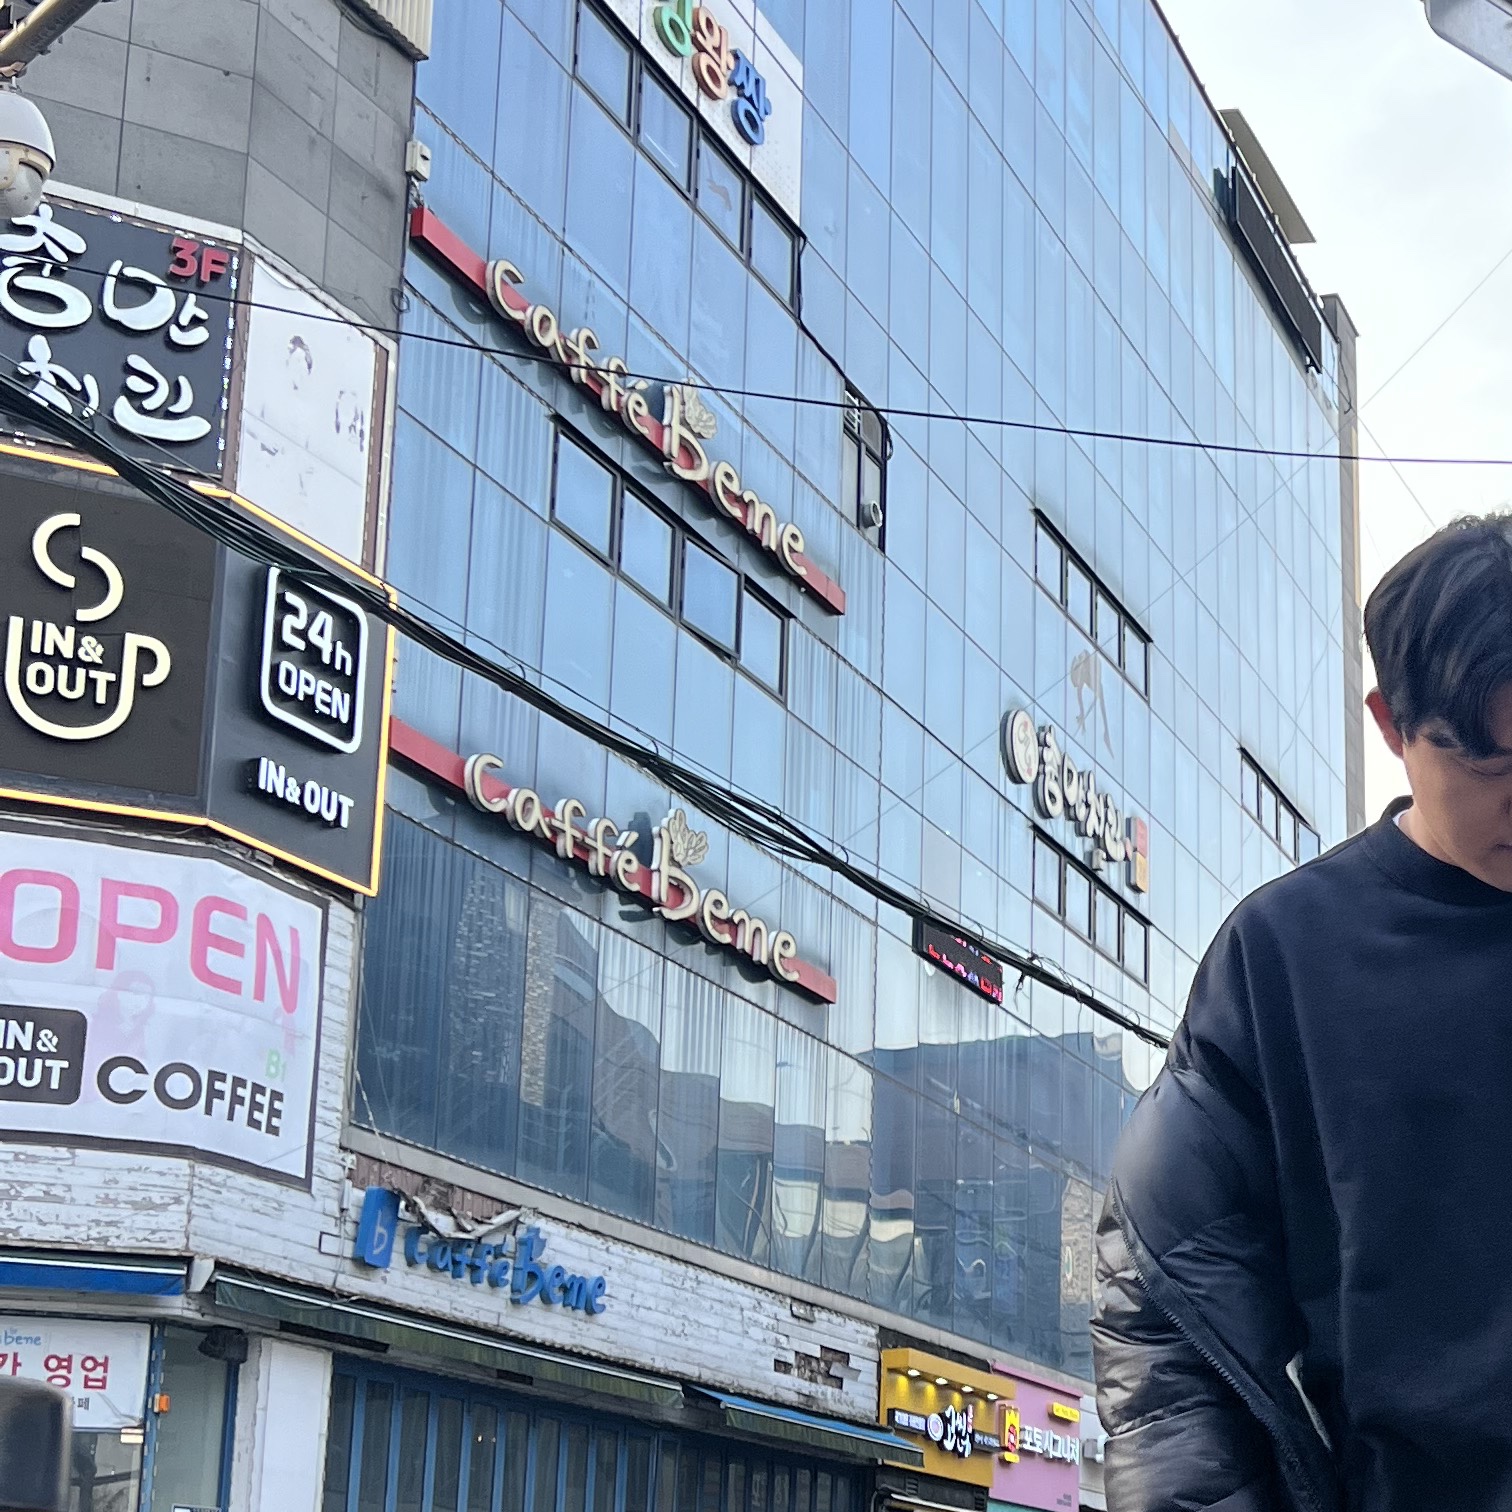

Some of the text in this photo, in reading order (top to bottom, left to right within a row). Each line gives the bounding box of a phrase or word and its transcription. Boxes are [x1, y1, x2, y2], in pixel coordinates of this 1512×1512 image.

[170, 237, 229, 282] 3F
[30, 619, 105, 664] IN&
[281, 590, 353, 676] 24h
[25, 661, 117, 706] OUT
[278, 660, 351, 724] OPEN
[0, 868, 299, 1014] OPEN
[0, 1057, 69, 1090] OUT
[97, 1055, 285, 1137] COFFEE
[44, 1353, 110, 1390] 영업
